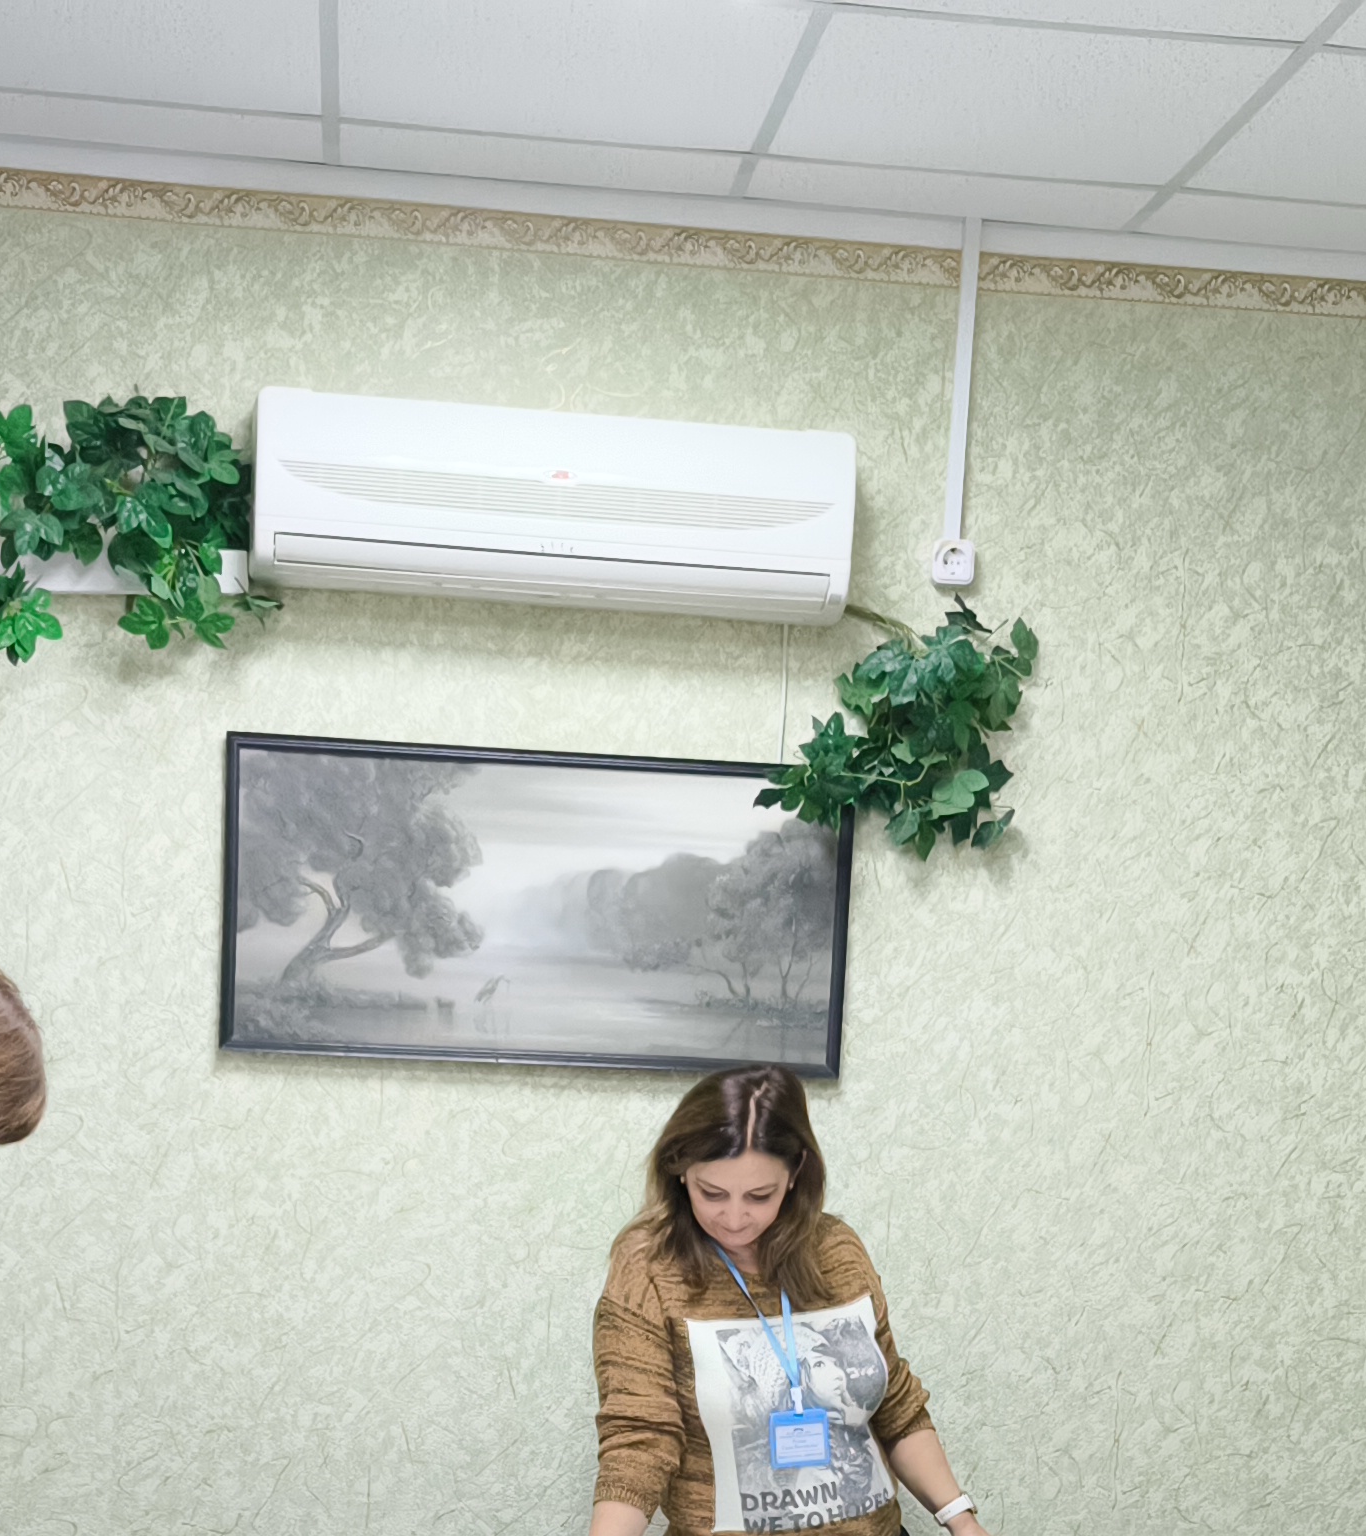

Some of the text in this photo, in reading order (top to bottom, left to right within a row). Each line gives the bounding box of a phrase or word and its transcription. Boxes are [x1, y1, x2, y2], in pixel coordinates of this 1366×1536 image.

[741, 1481, 837, 1511] DRAWN
[744, 1516, 783, 1535] WE
[788, 1511, 824, 1532] TO
